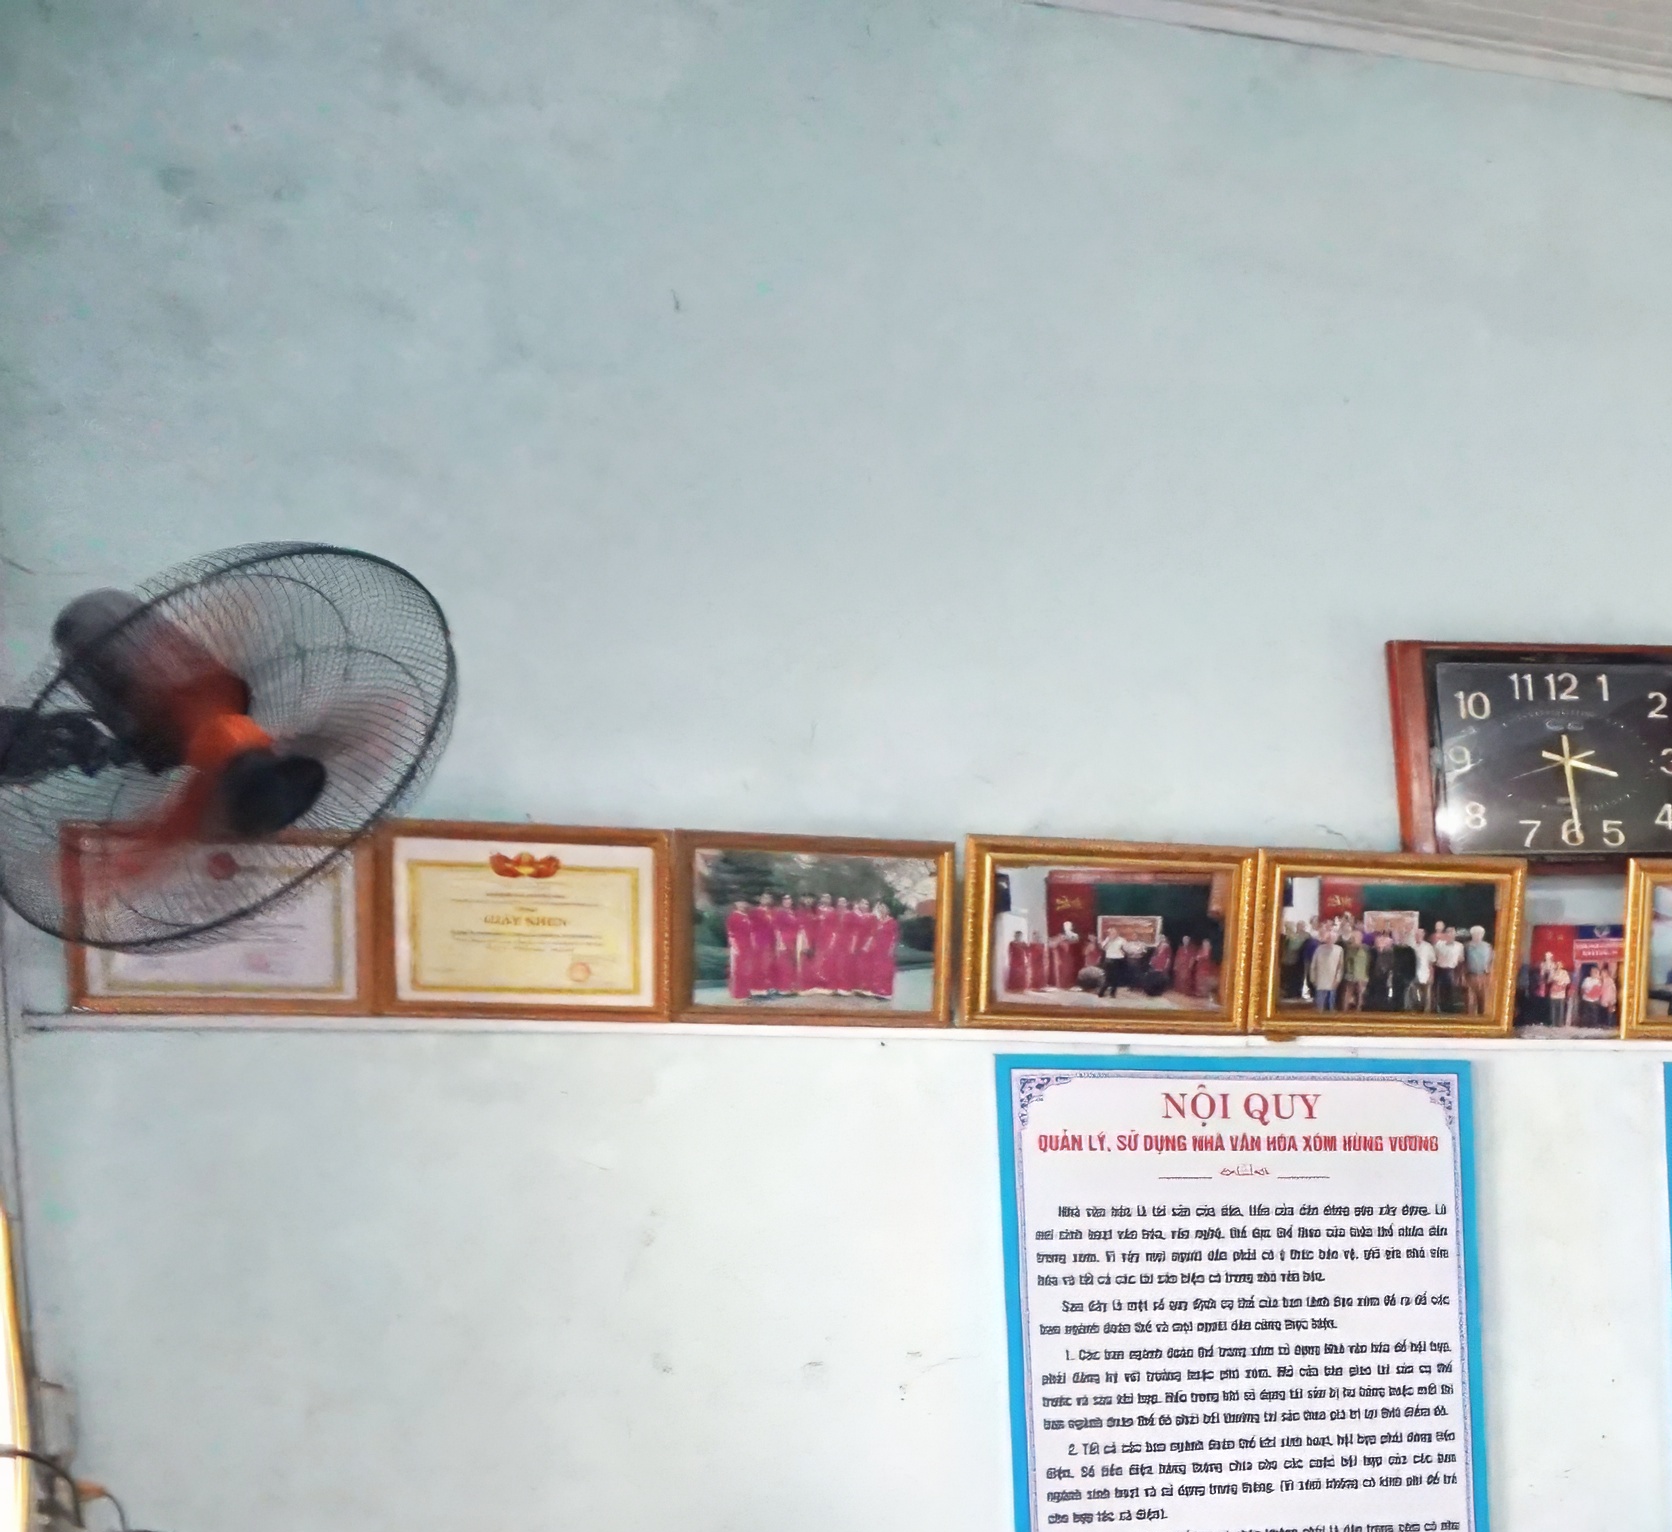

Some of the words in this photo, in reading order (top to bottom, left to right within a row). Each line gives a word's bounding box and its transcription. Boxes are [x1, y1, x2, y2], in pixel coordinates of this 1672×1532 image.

[1509, 672, 1534, 701] 11
[1544, 672, 1579, 701] 12
[1597, 673, 1609, 701] 1
[1454, 690, 1491, 720] 10
[1648, 691, 1668, 719] 2
[1449, 745, 1470, 774] 9
[1465, 802, 1487, 830] 8
[1519, 820, 1541, 848] 7
[1561, 818, 1584, 847] 6
[1602, 820, 1625, 847] 5
[1162, 1084, 1230, 1127] NỘI
[1244, 1092, 1321, 1126] QUY
[1038, 1129, 1083, 1152] QUẢN
[1117, 1129, 1139, 1151] SỬ
[1144, 1134, 1186, 1155] DỤNG
[1192, 1132, 1225, 1151] NHÀ
[1230, 1132, 1261, 1151] VĂN
[1303, 1132, 1337, 1152] XÓM
[1343, 1131, 1383, 1151] HÙNG
